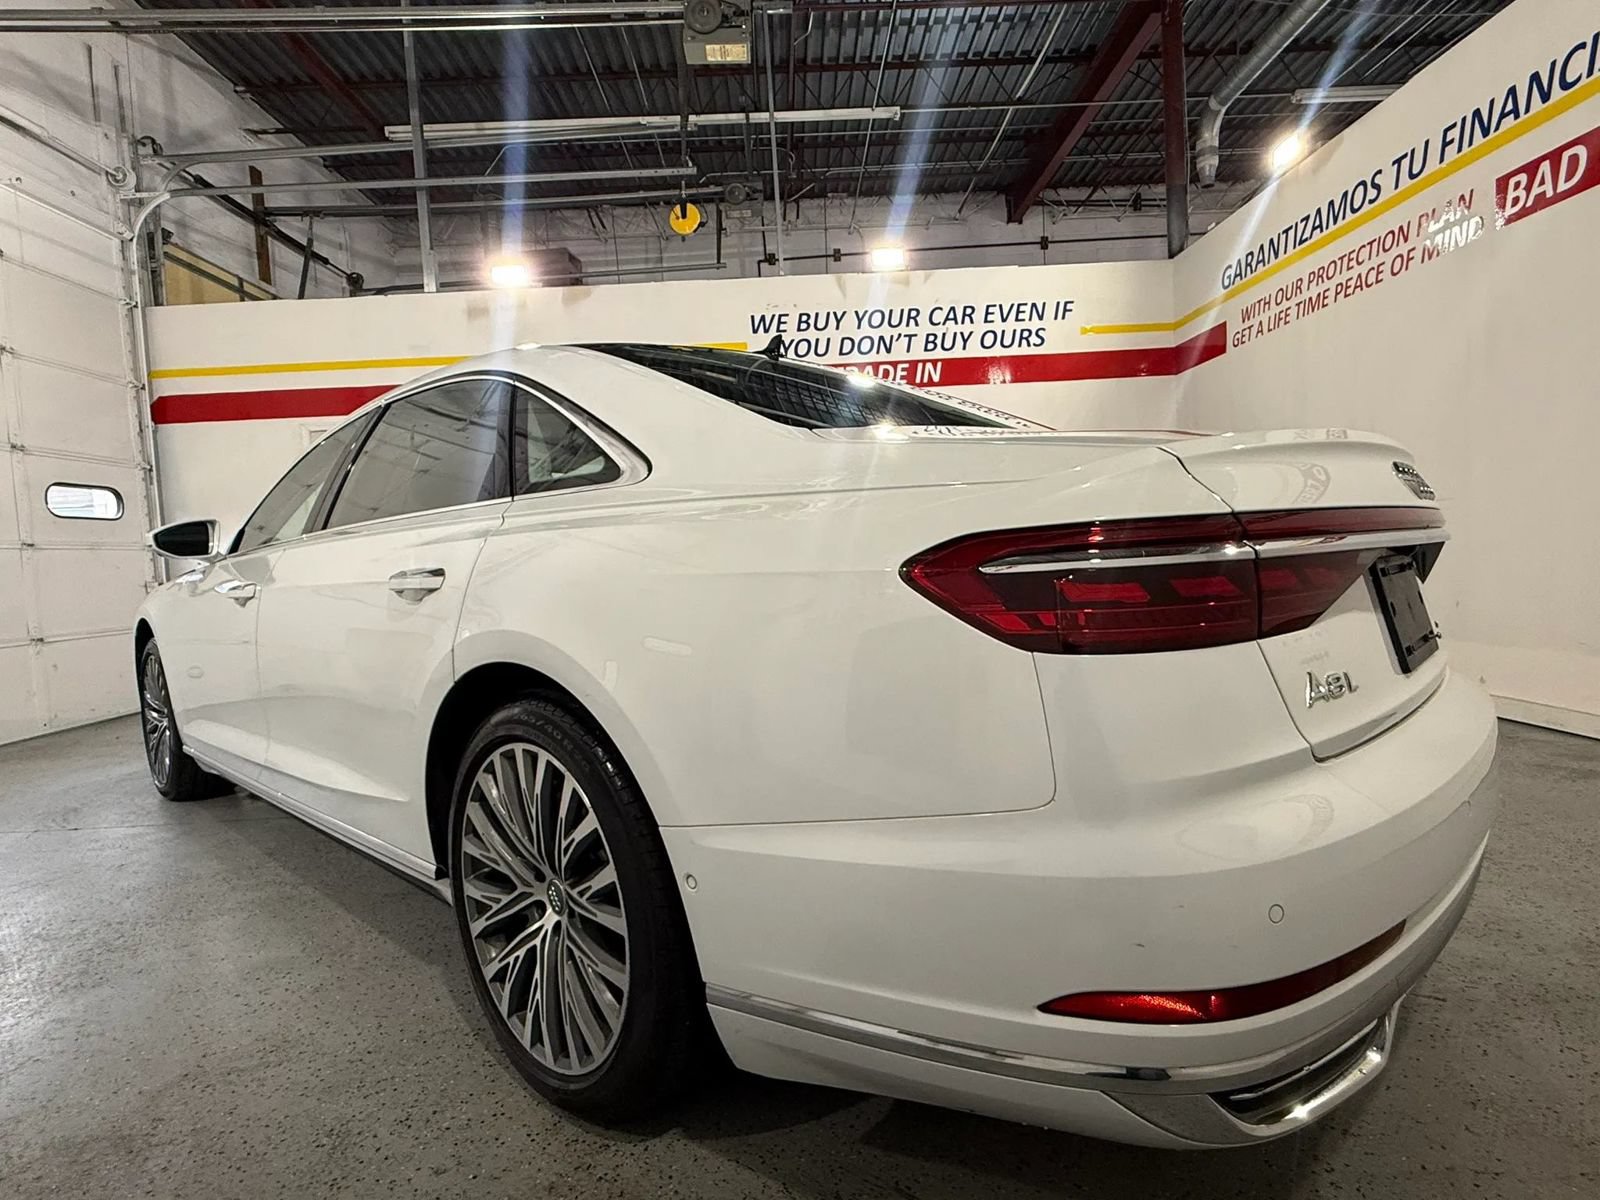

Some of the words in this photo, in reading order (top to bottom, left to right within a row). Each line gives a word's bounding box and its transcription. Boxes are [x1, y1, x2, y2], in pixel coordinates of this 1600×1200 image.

[1221, 169, 1382, 291] GARANTIZAMOS
[1391, 138, 1430, 190] TU
[1438, 31, 1600, 165] FINANCI
[1504, 144, 1588, 218] BAD
[1232, 324, 1254, 348] GET
[1255, 319, 1264, 339] A
[1267, 306, 1292, 333] LIFE
[1295, 287, 1330, 320] TIME
[1334, 261, 1386, 303] PEACE
[1390, 246, 1417, 277] OF
[1420, 215, 1485, 265] MIND
[1241, 293, 1272, 324] WITH
[1275, 277, 1303, 307] OUR
[1306, 220, 1411, 291] PROTECTION
[1416, 188, 1474, 237] PLAN
[750, 313, 790, 334] WE
[796, 310, 847, 332] BUY
[854, 307, 921, 330] YOUR
[928, 305, 976, 327] CAR
[983, 301, 1047, 324] EVEN
[1053, 300, 1074, 320] IF
[780, 337, 831, 358] YOU
[838, 332, 918, 356] DON’T
[923, 330, 974, 352] BUY
[980, 327, 1046, 350] OURS
[915, 361, 942, 384] IN
[1304, 671, 1359, 709] A8L
